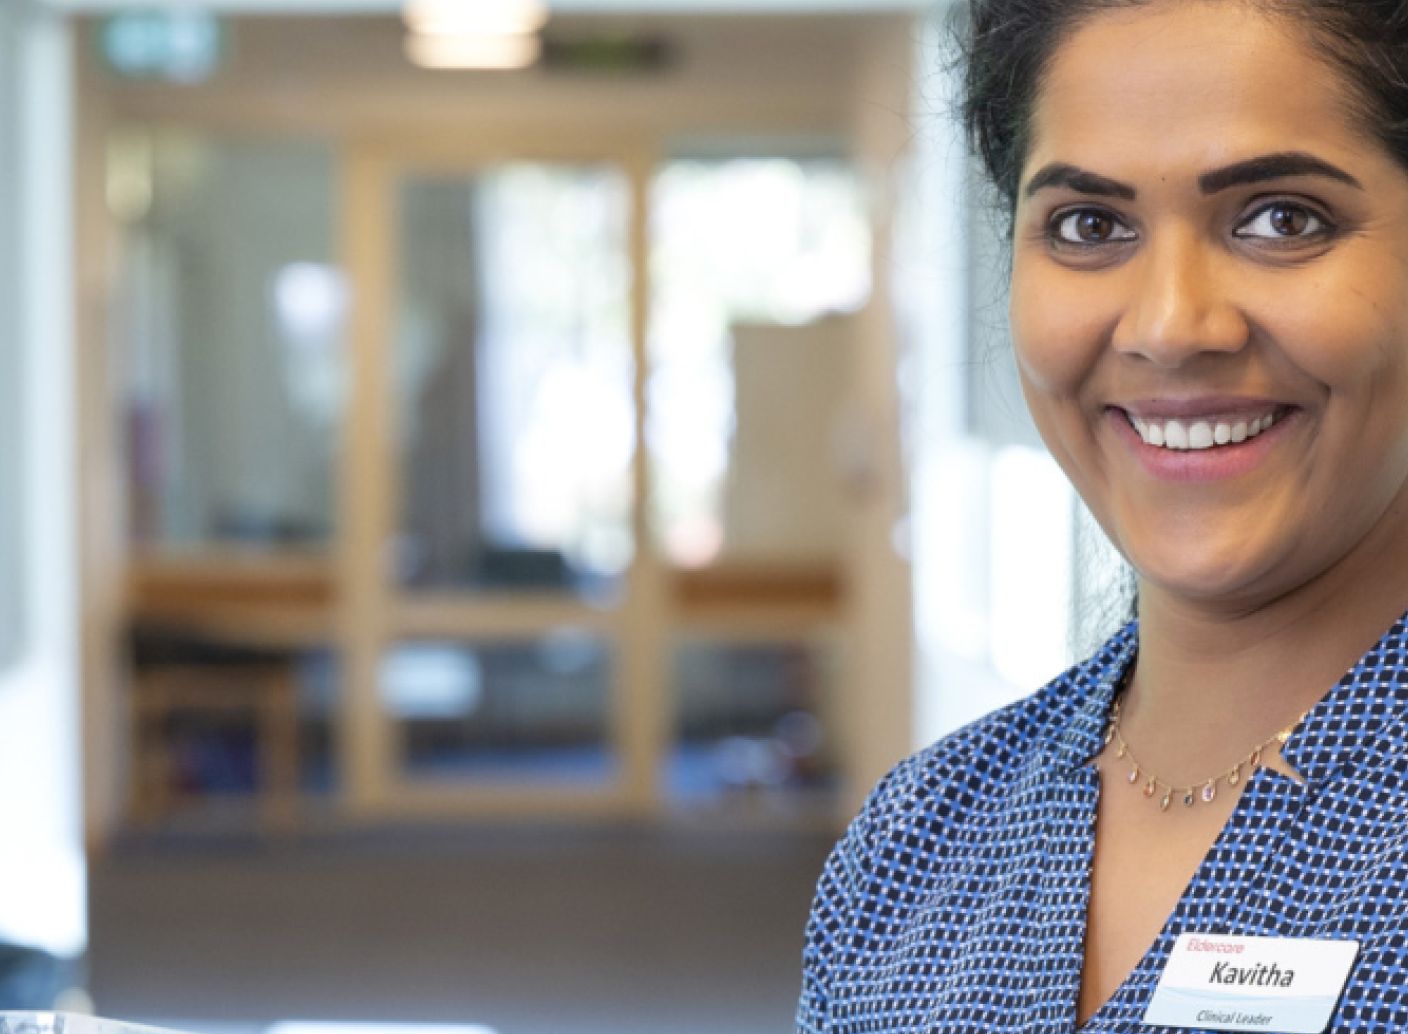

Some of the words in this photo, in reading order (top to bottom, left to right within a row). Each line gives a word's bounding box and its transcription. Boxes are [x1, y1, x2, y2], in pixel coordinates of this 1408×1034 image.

[1186, 938, 1245, 954] Eldercare
[1209, 961, 1295, 987] Kavitha
[1196, 1009, 1234, 1024] Clinical
[1236, 1012, 1273, 1025] Leader
